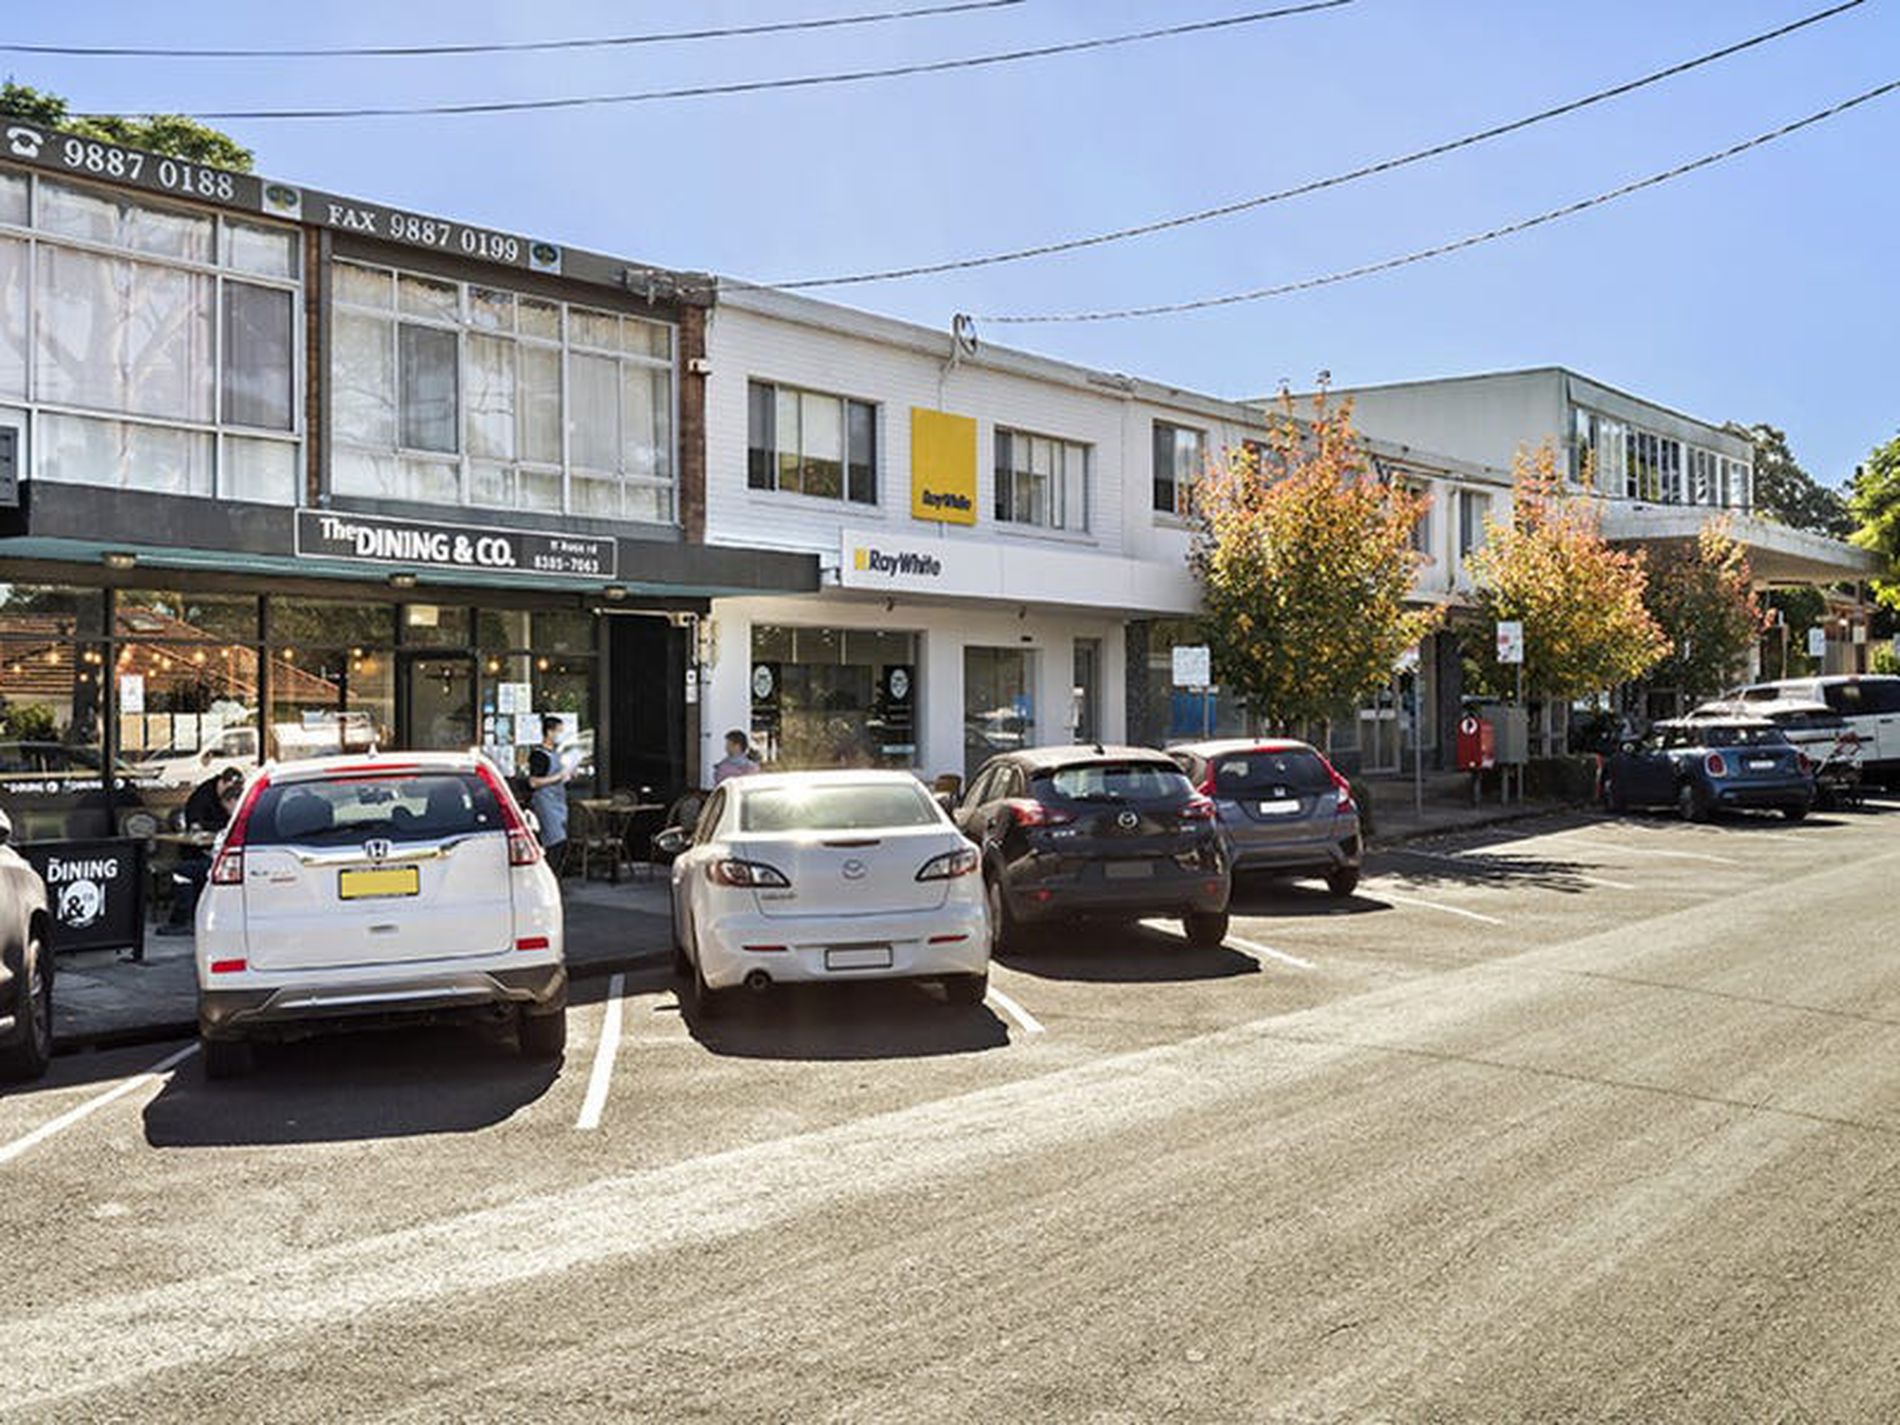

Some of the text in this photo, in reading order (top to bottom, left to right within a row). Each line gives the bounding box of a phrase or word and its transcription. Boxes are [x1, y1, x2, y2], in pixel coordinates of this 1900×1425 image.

[63, 138, 235, 201] 9887 0188
[327, 203, 520, 263] FAX 9887 0199
[320, 517, 357, 541] The
[355, 526, 516, 567] DINING & CO.
[47, 858, 118, 883] DINING
